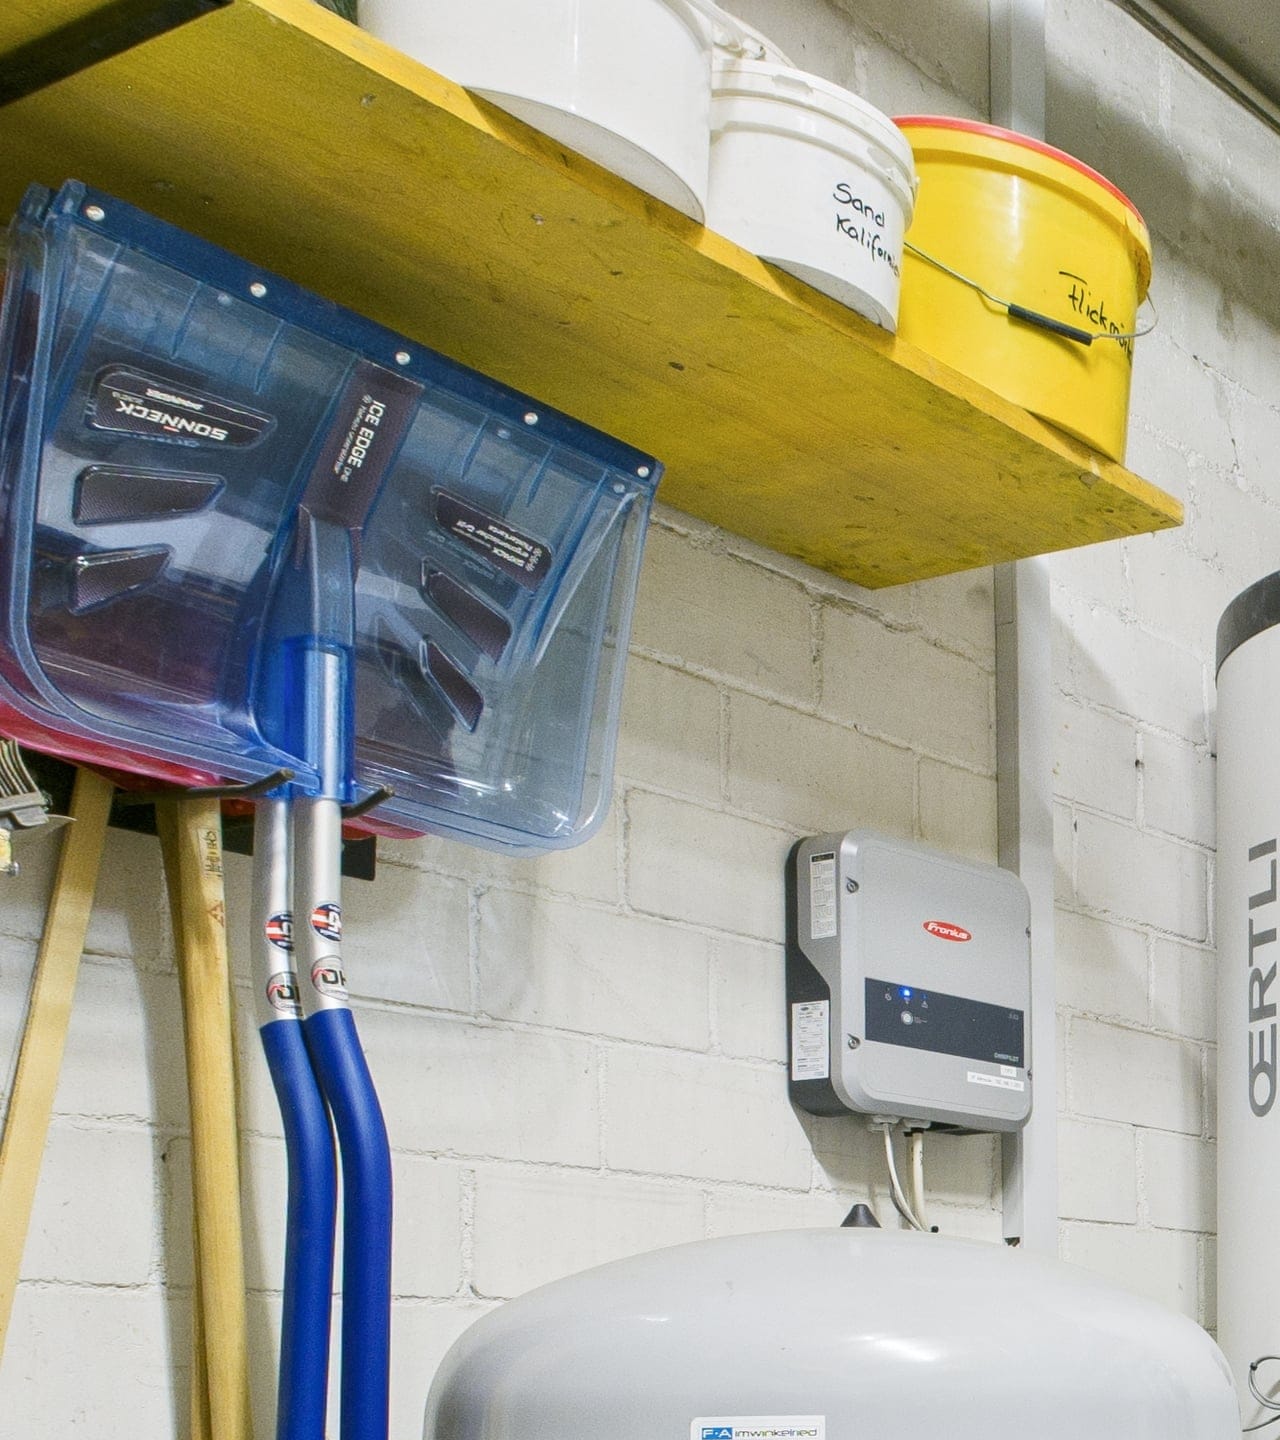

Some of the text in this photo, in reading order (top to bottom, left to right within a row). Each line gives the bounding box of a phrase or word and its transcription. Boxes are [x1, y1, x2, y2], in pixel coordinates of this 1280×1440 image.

[832, 183, 885, 227] Sand
[115, 400, 229, 441] SONNECK
[364, 400, 387, 427] ICE
[347, 426, 375, 468] EDGE
[926, 922, 969, 941] Fronius
[734, 1429, 818, 1438] imwinkelried
